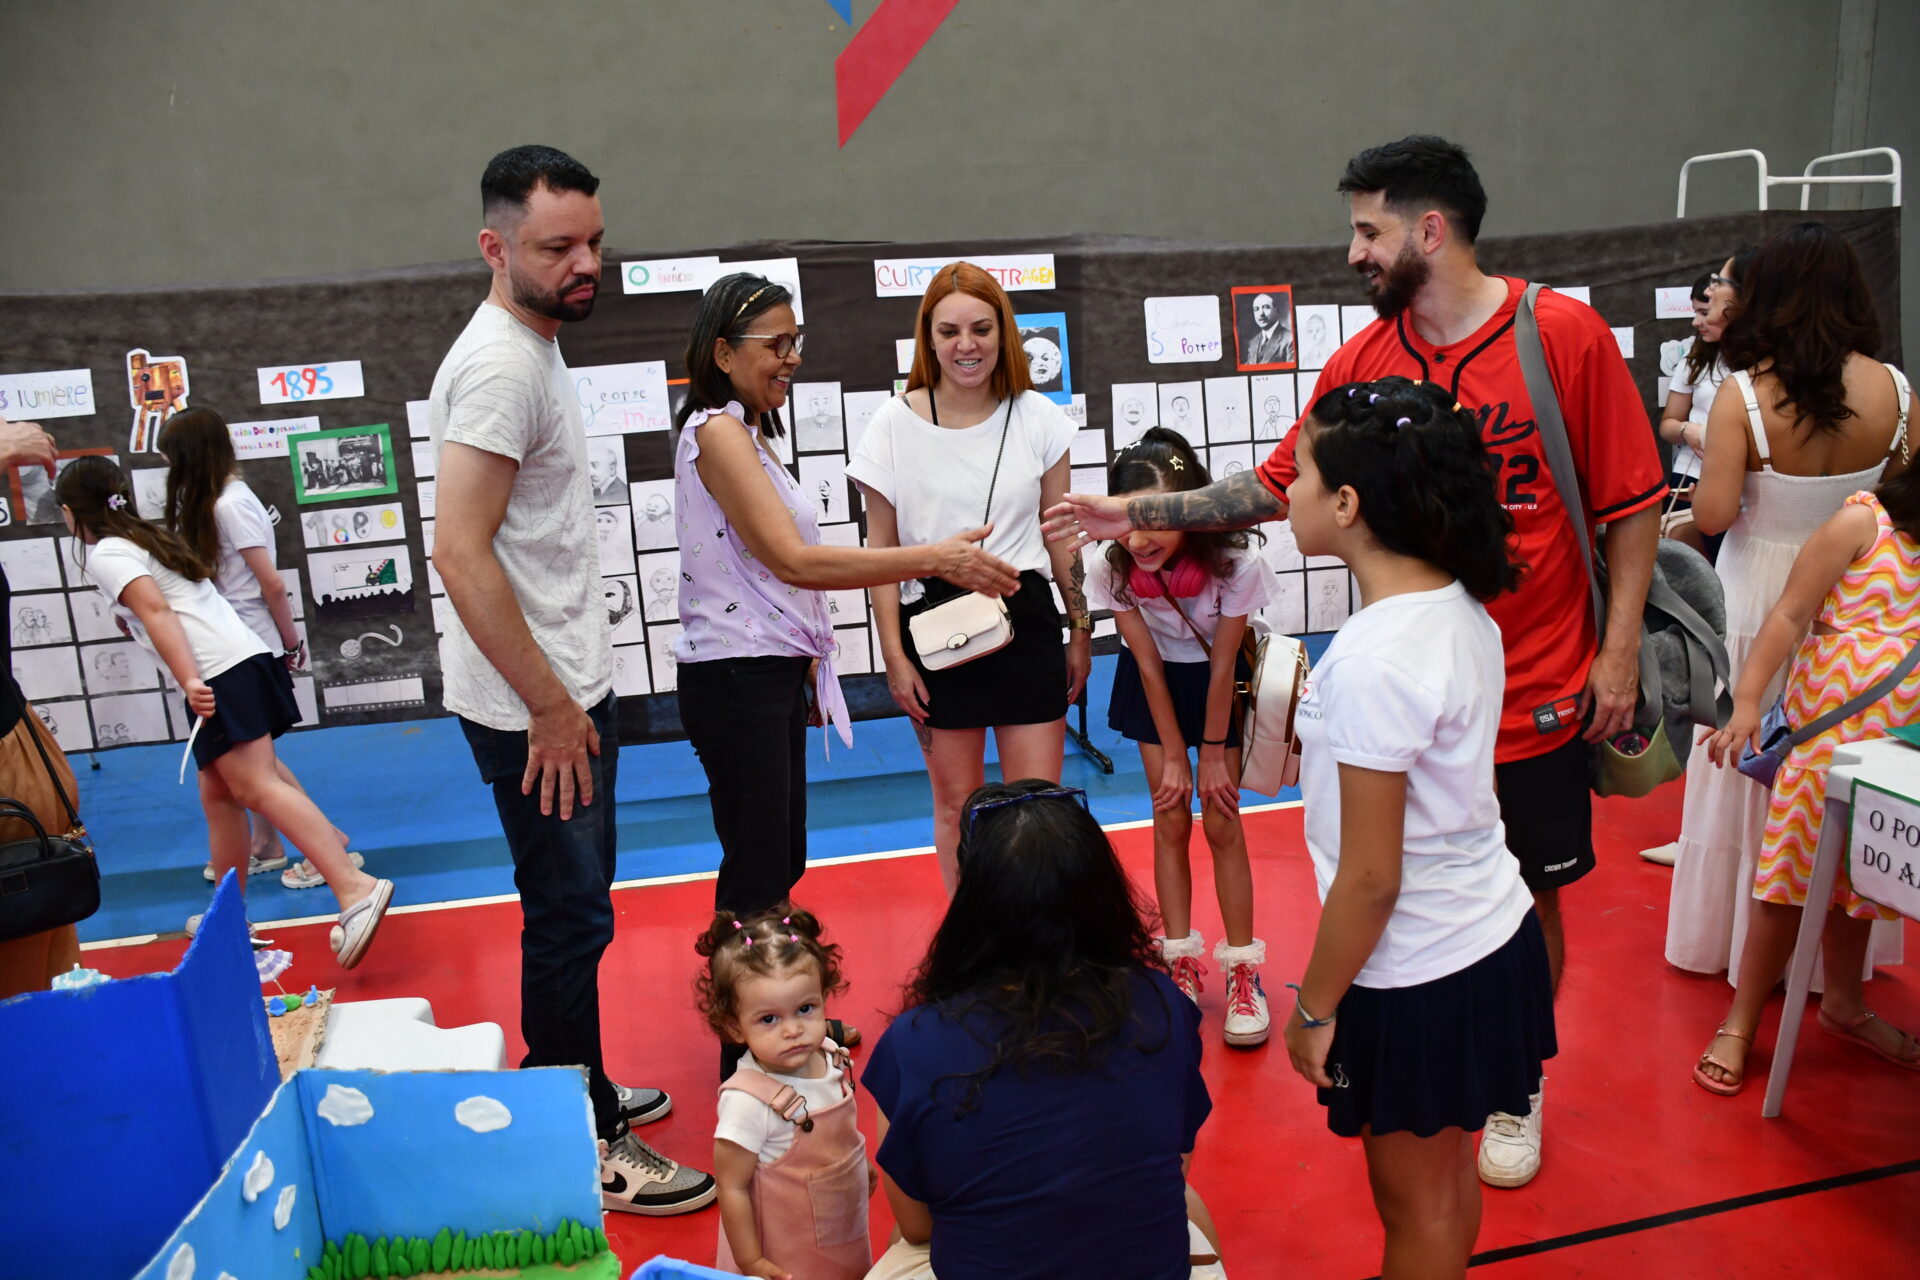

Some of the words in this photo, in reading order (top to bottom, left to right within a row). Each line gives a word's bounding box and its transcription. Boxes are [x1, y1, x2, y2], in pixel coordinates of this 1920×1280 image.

[628, 264, 650, 286] O
[876, 264, 943, 288] CURT
[270, 366, 334, 400] 1895
[1539, 712, 1555, 724] USA
[1869, 810, 1884, 832] O
[1862, 843, 1891, 873] DO
[1898, 862, 1920, 888] A
